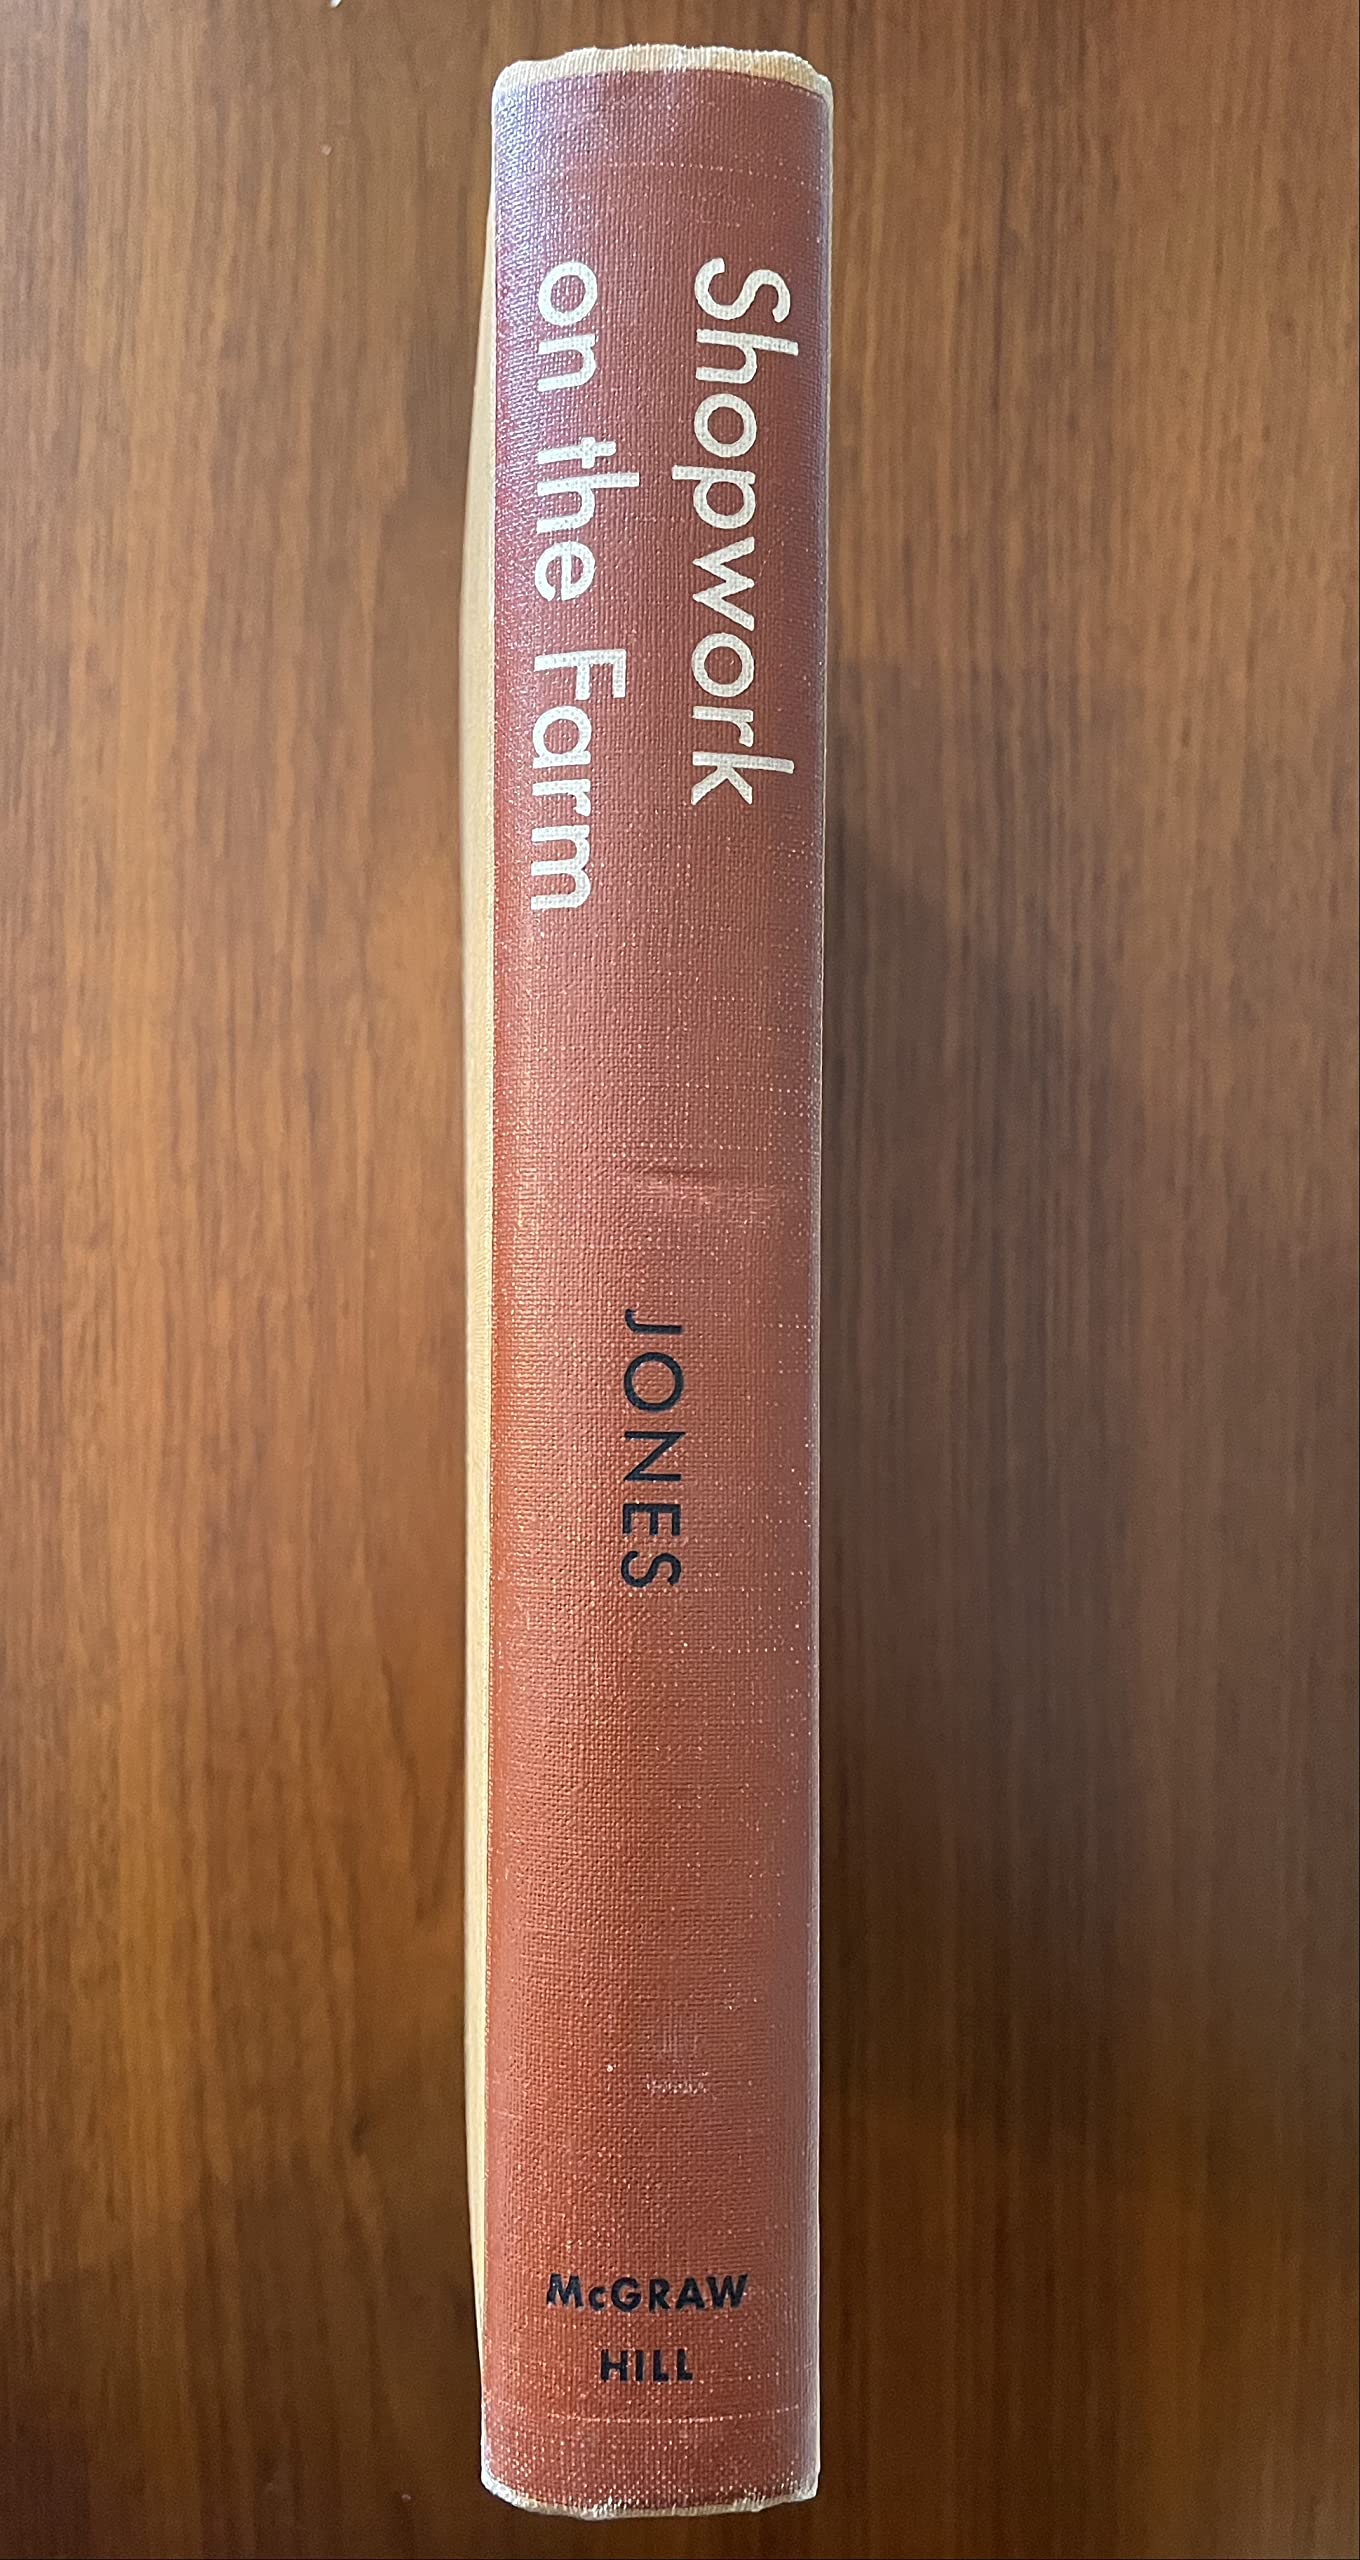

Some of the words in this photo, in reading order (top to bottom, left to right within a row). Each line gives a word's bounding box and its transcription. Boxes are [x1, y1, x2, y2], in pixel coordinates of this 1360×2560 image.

[536, 260, 599, 392] on
[534, 436, 640, 602] the
[671, 257, 800, 806] Shopwork
[530, 648, 627, 911] Farm
[621, 1308, 686, 1588] JONES
[546, 2273, 748, 2312] McGRAW
[600, 2349, 693, 2382] HILL
